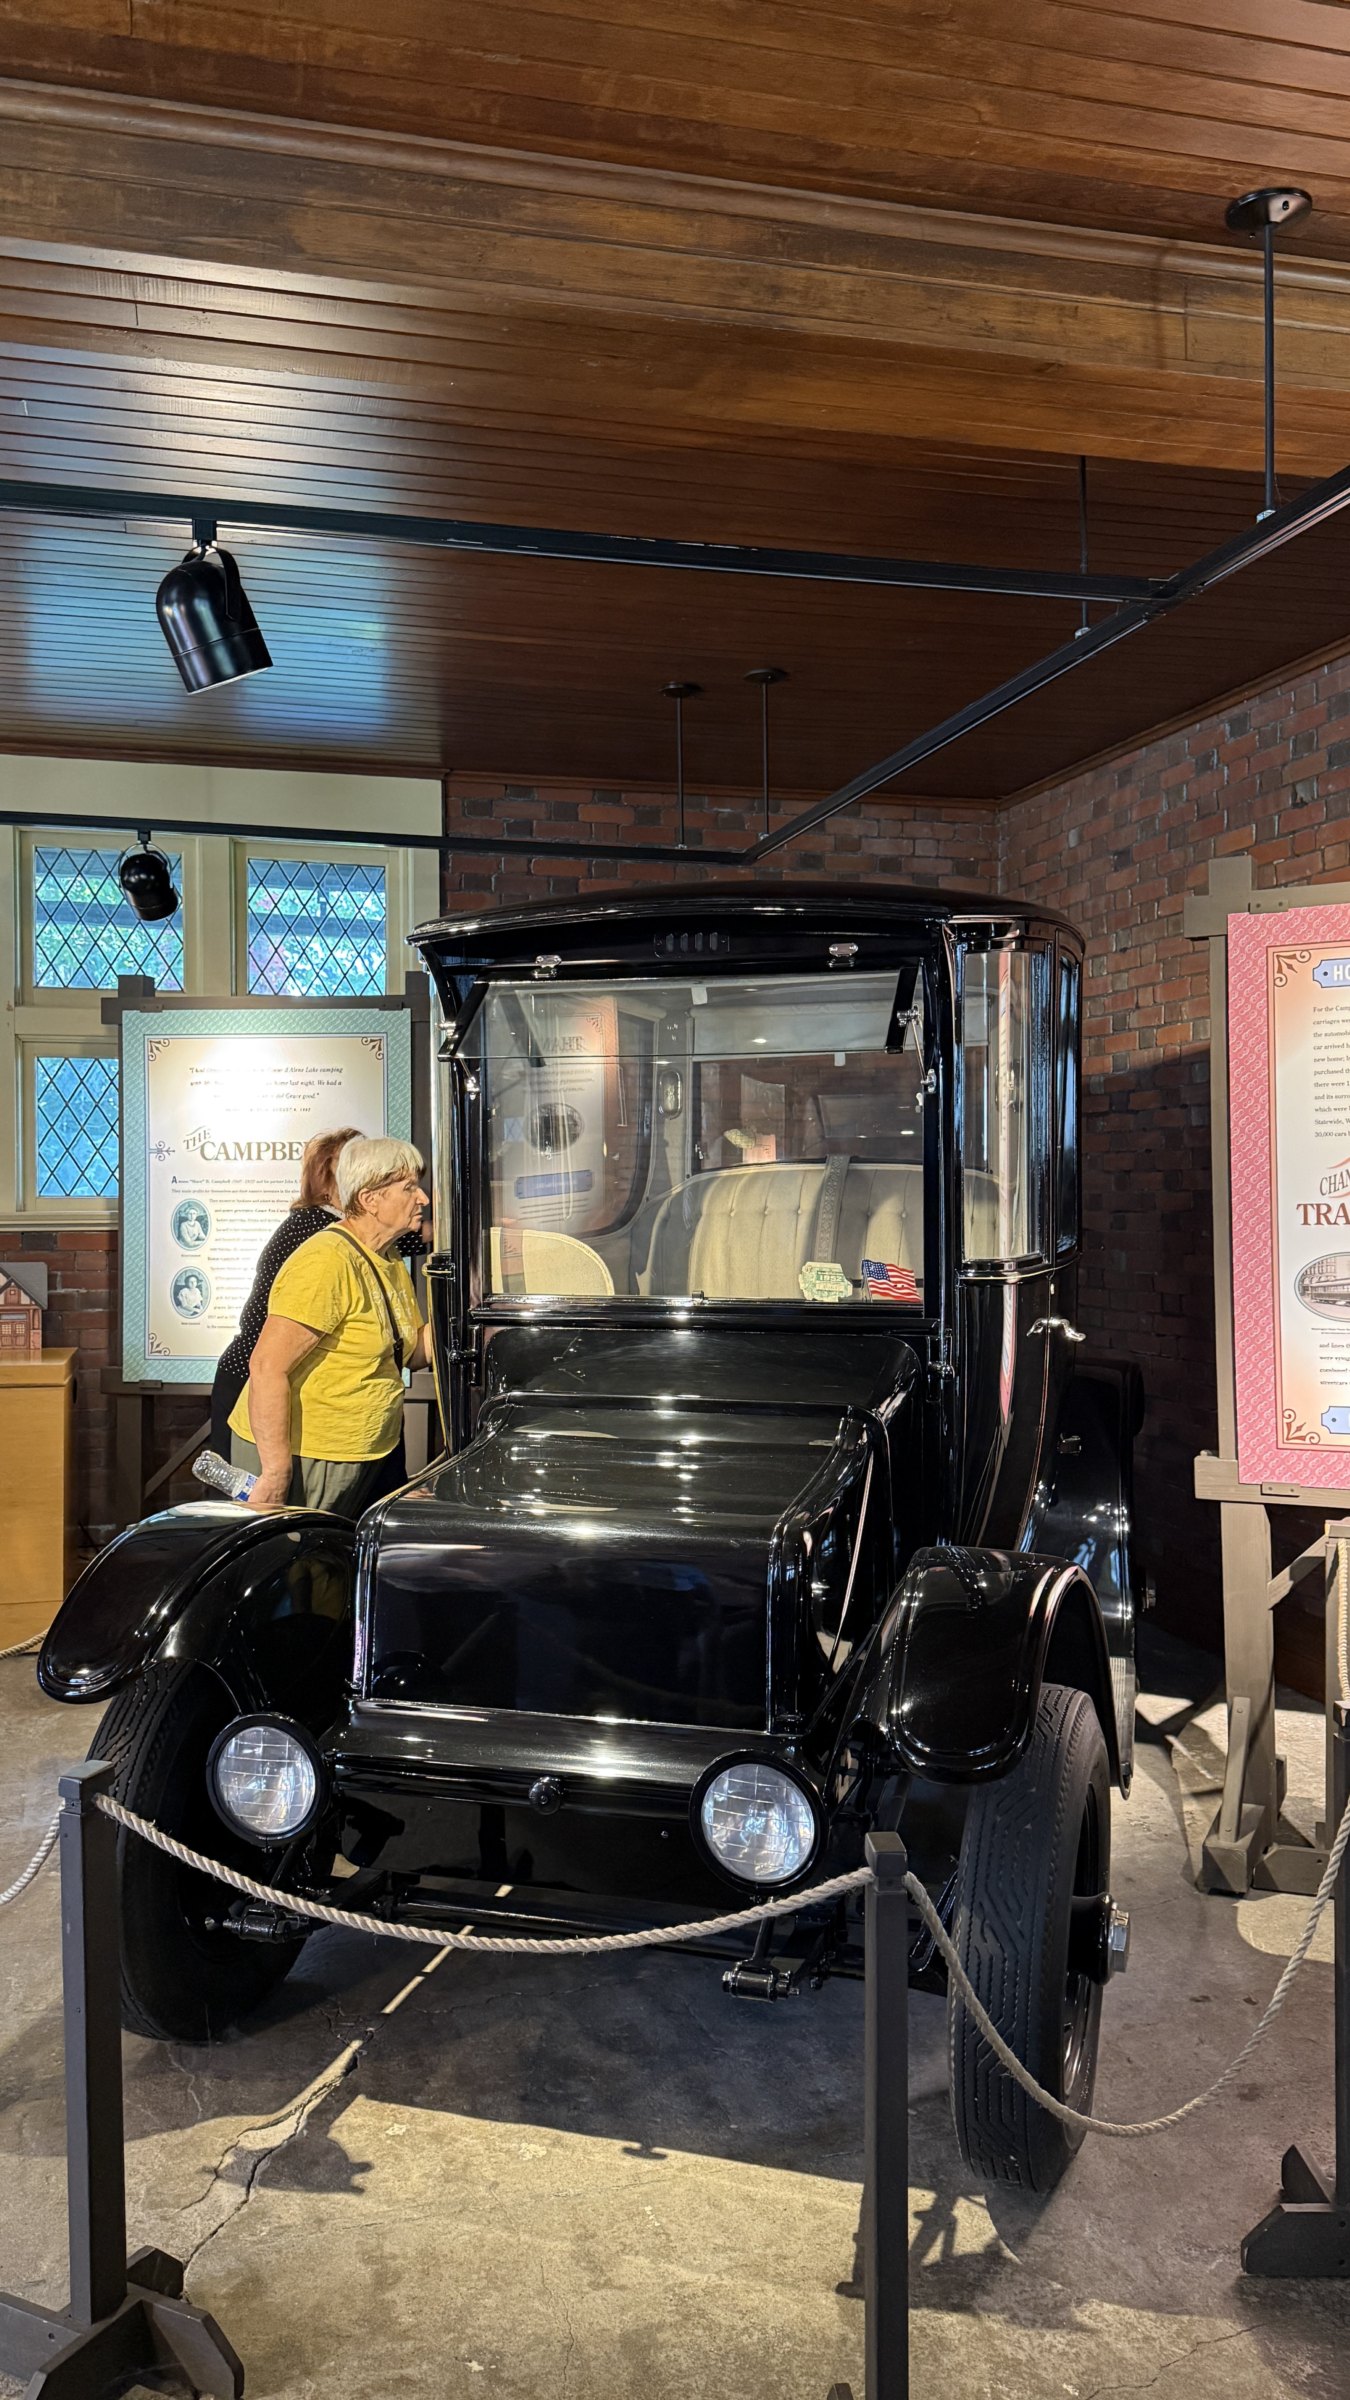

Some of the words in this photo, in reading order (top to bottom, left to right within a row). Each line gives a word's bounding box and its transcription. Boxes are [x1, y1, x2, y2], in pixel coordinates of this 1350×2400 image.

[1314, 1068, 1344, 1076] purchased
[183, 1128, 211, 1150] THE
[1296, 1202, 1350, 1226] TRA
